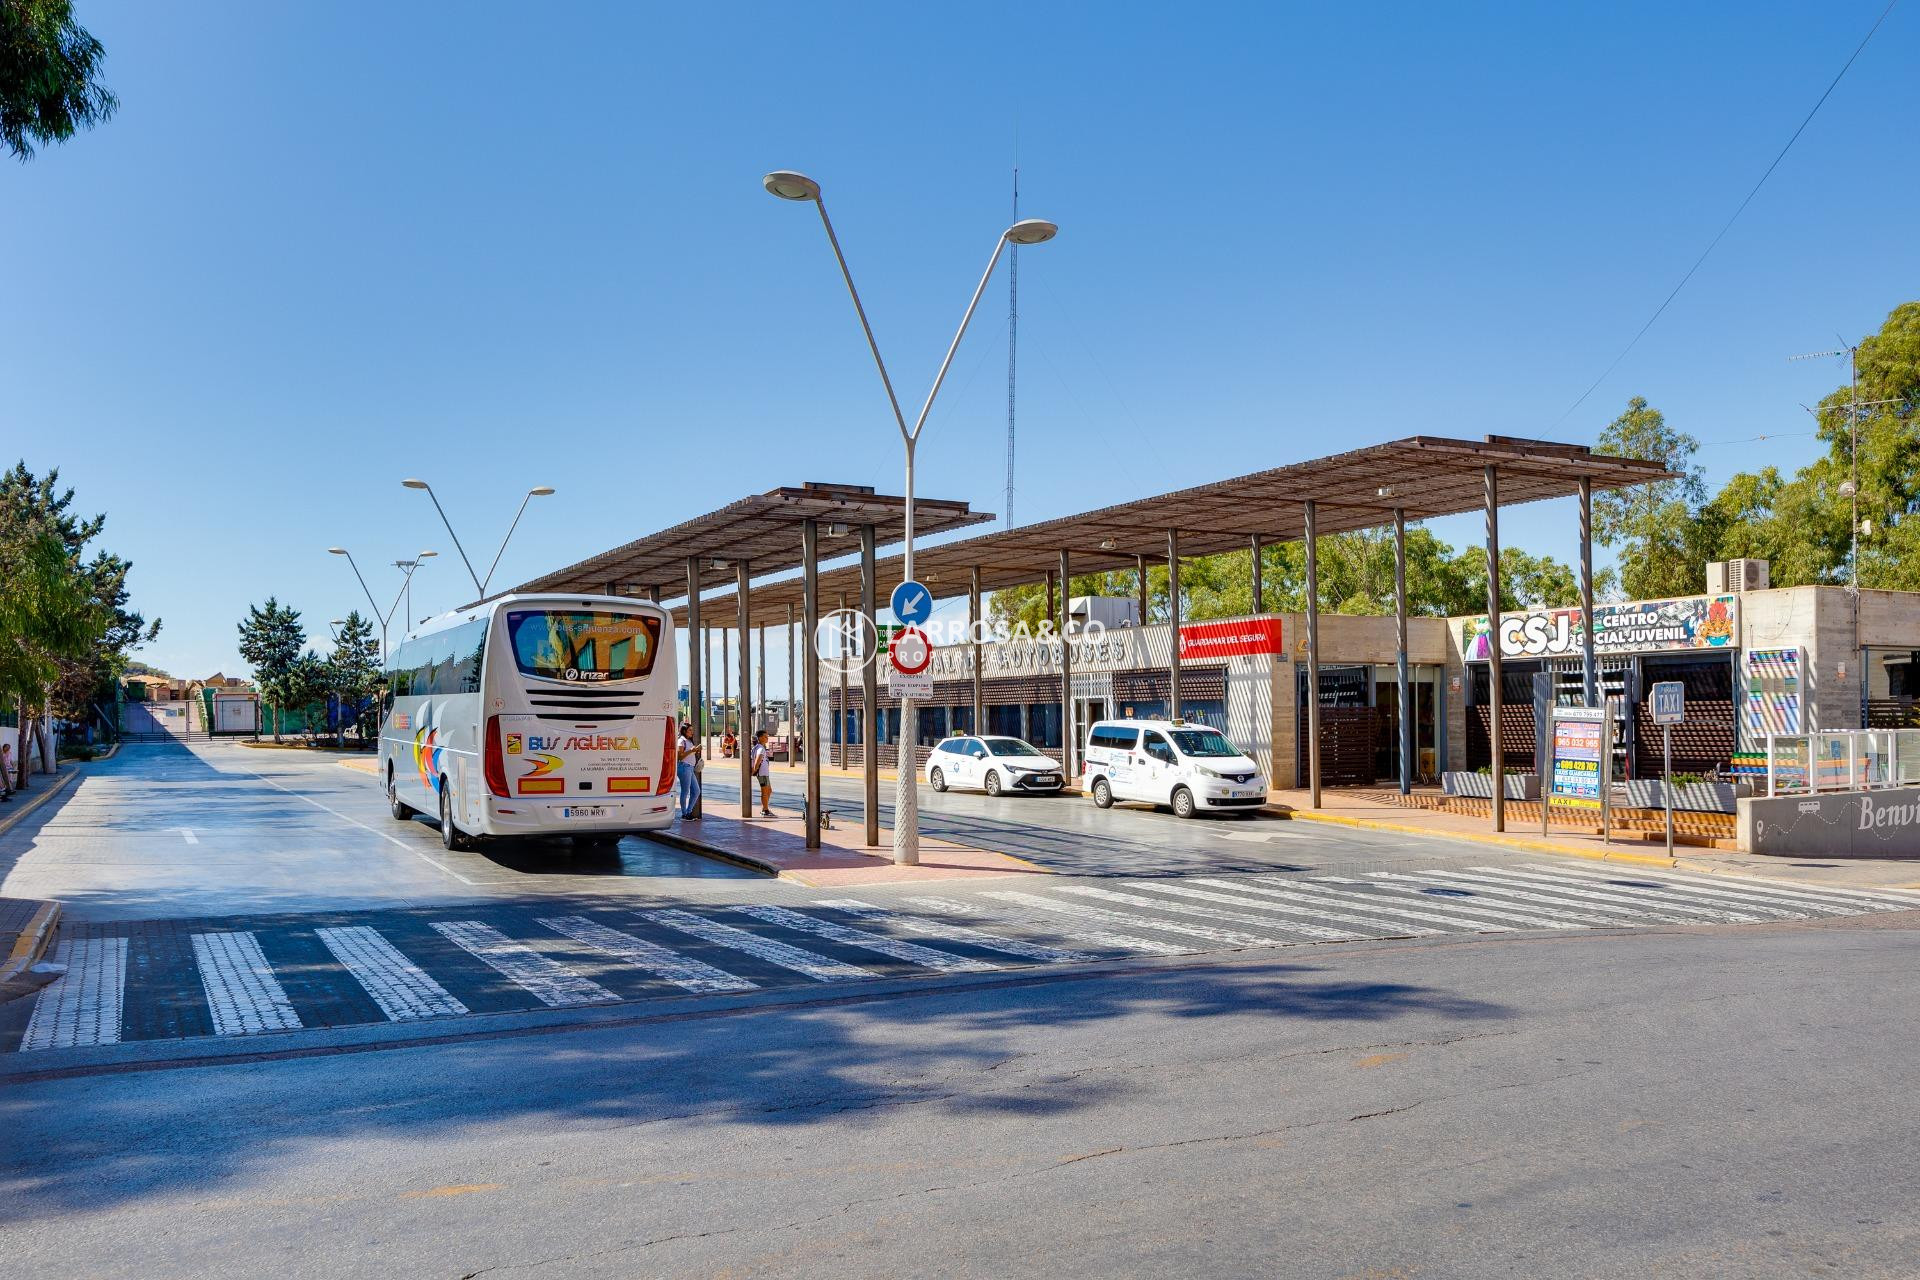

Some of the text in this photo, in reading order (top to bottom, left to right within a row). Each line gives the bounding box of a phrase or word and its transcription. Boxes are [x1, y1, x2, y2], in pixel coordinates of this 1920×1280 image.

[1603, 612, 1659, 628] CENTRO
[1187, 633, 1267, 647] GUARDAMAR DEL SEGURA
[1500, 616, 1569, 655] CSJ
[1576, 626, 1688, 646] SCIAL JUVENIL
[999, 636, 1125, 669] AUTOBUSES
[1658, 694, 1680, 713] TAXI
[528, 736, 561, 751] BUS
